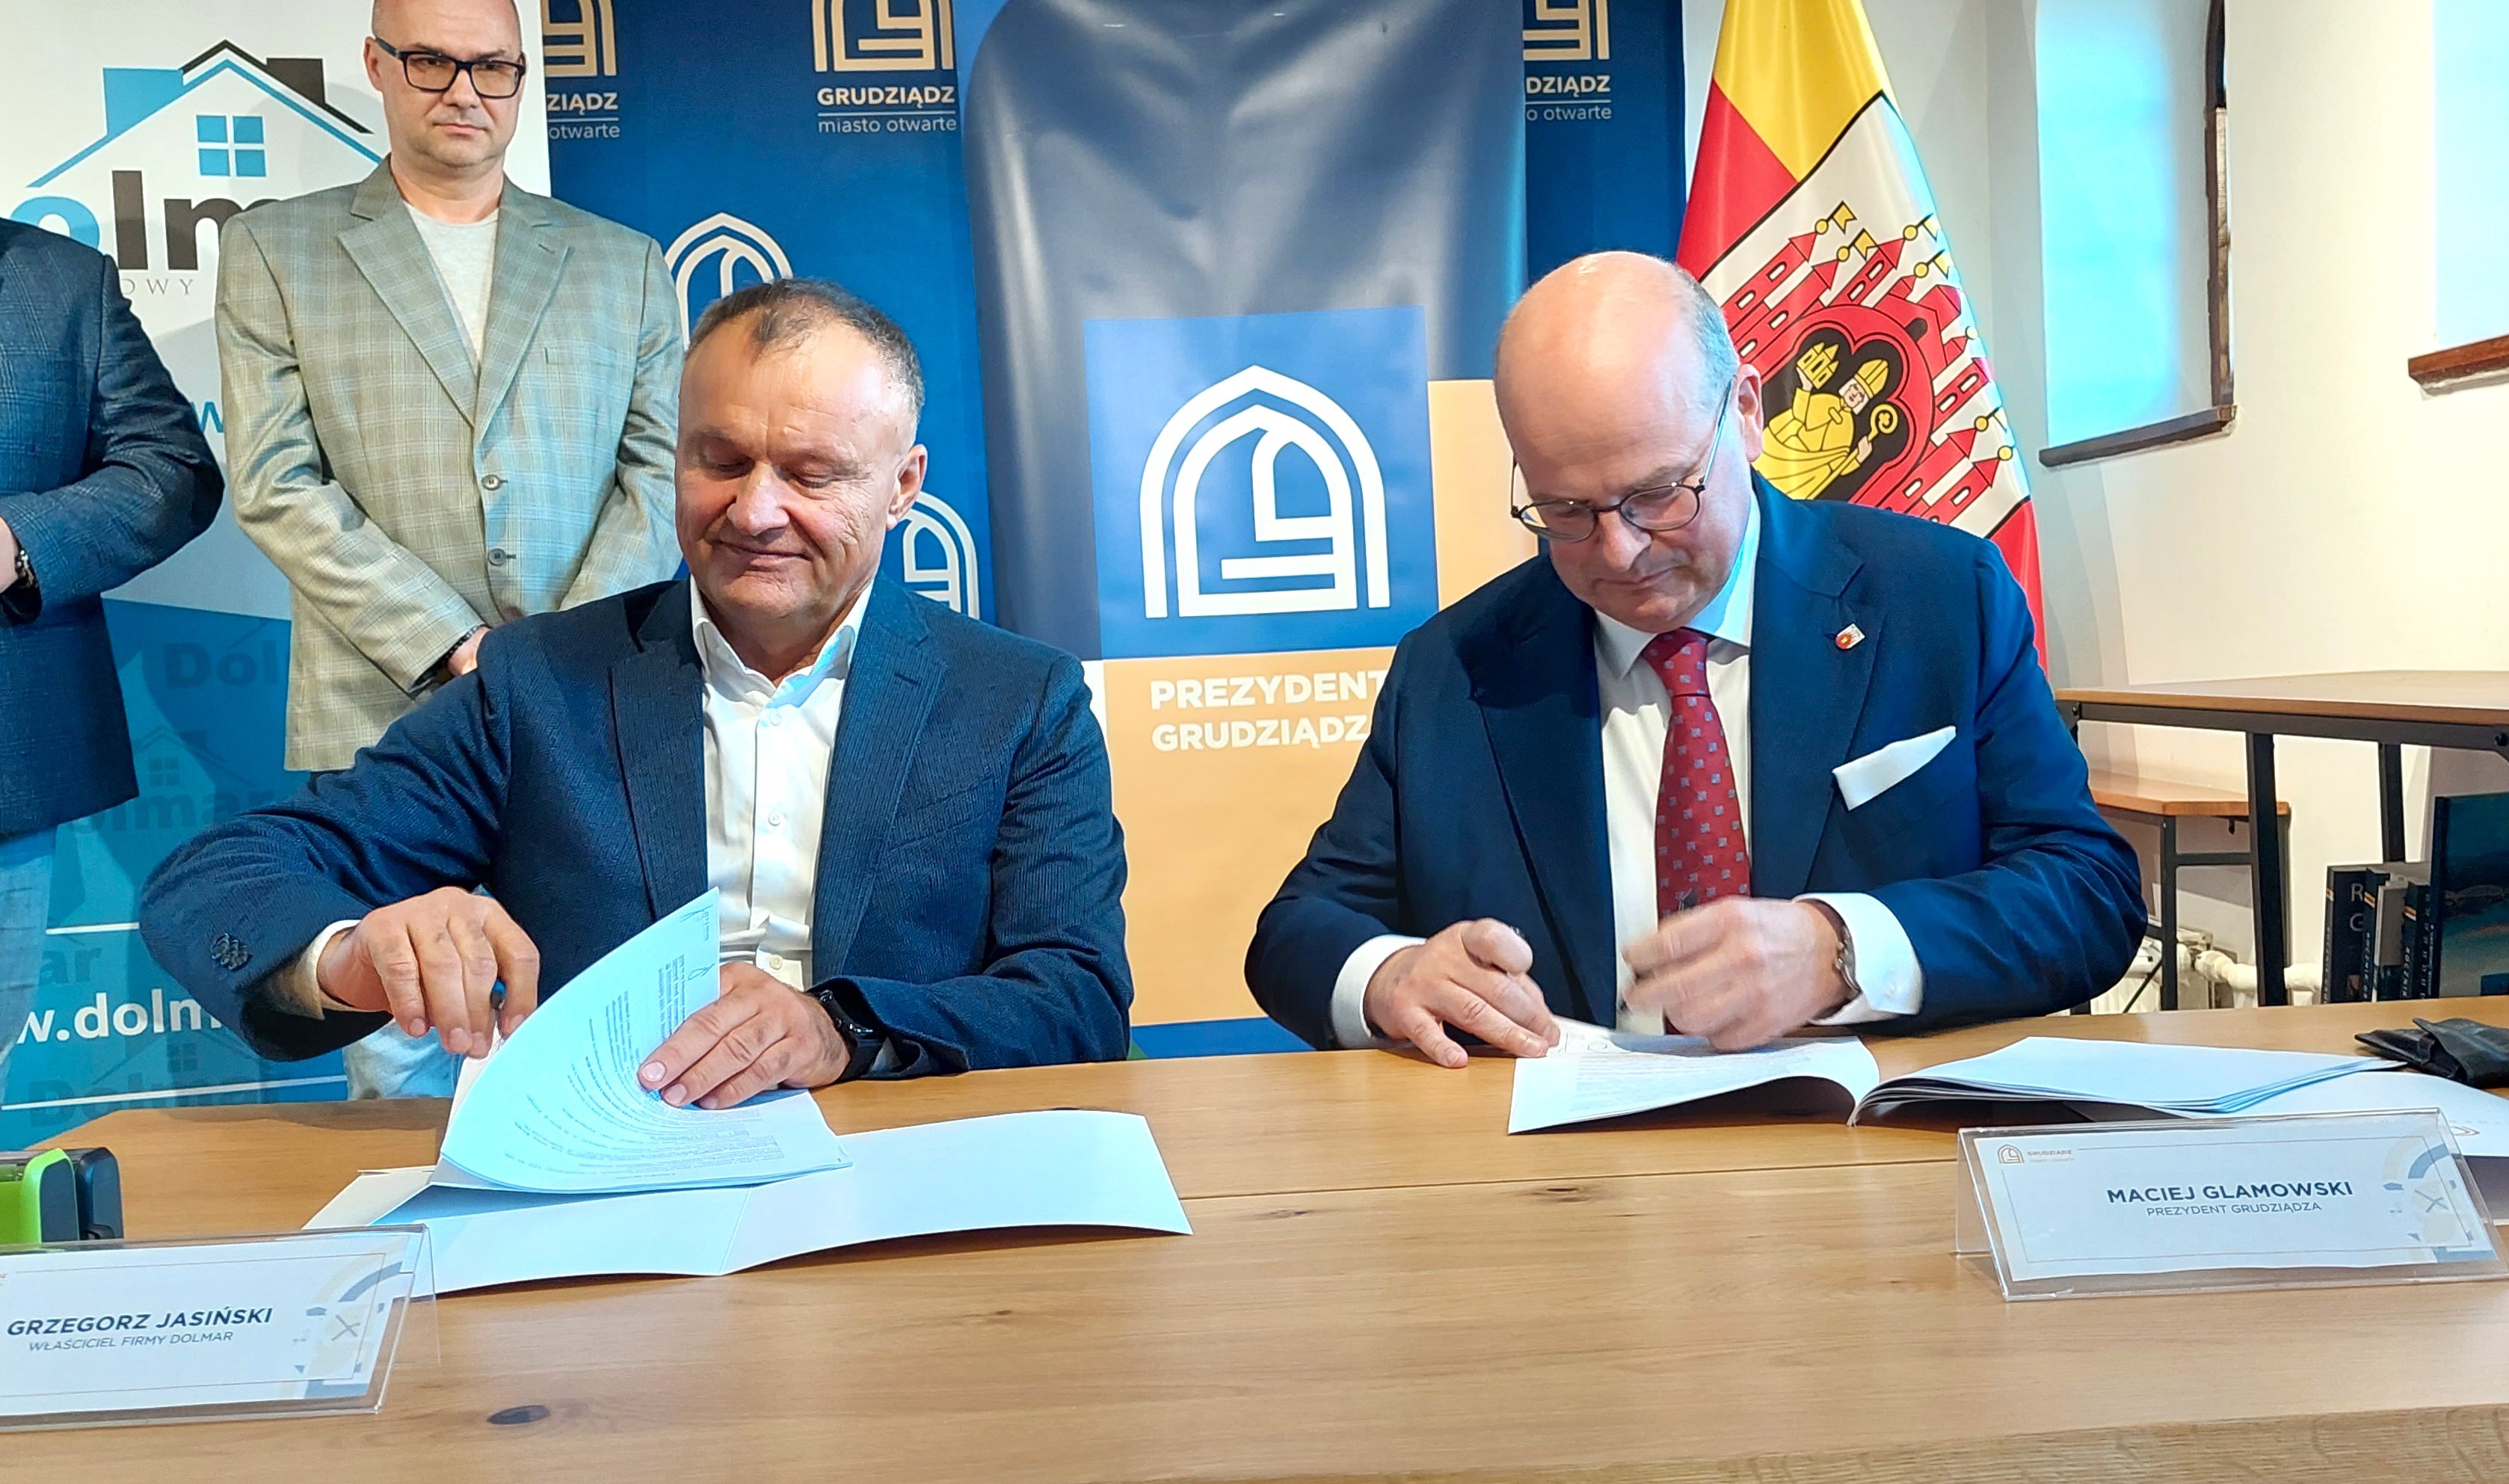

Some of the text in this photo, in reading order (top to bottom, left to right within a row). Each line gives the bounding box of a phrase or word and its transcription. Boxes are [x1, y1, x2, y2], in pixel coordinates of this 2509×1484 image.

[1526, 75, 1610, 97] DZIĄDZ
[547, 92, 618, 115] ZIĄDZ
[817, 86, 955, 109] GRUDZIĄDZ
[1543, 105, 1612, 120] otwarte
[549, 123, 621, 139] otwarte
[818, 117, 957, 133] miasto otwarte
[2107, 1181, 2353, 1203] MACIEJ GLAMOWSKI
[2146, 1201, 2322, 1216] PREZYDENT GRUDZIĄDZA
[7, 1305, 273, 1336] GRZEGORZ JASIŃSKI
[29, 1331, 233, 1352] WŁAŚCICIEL FIRMY DOLMAR
